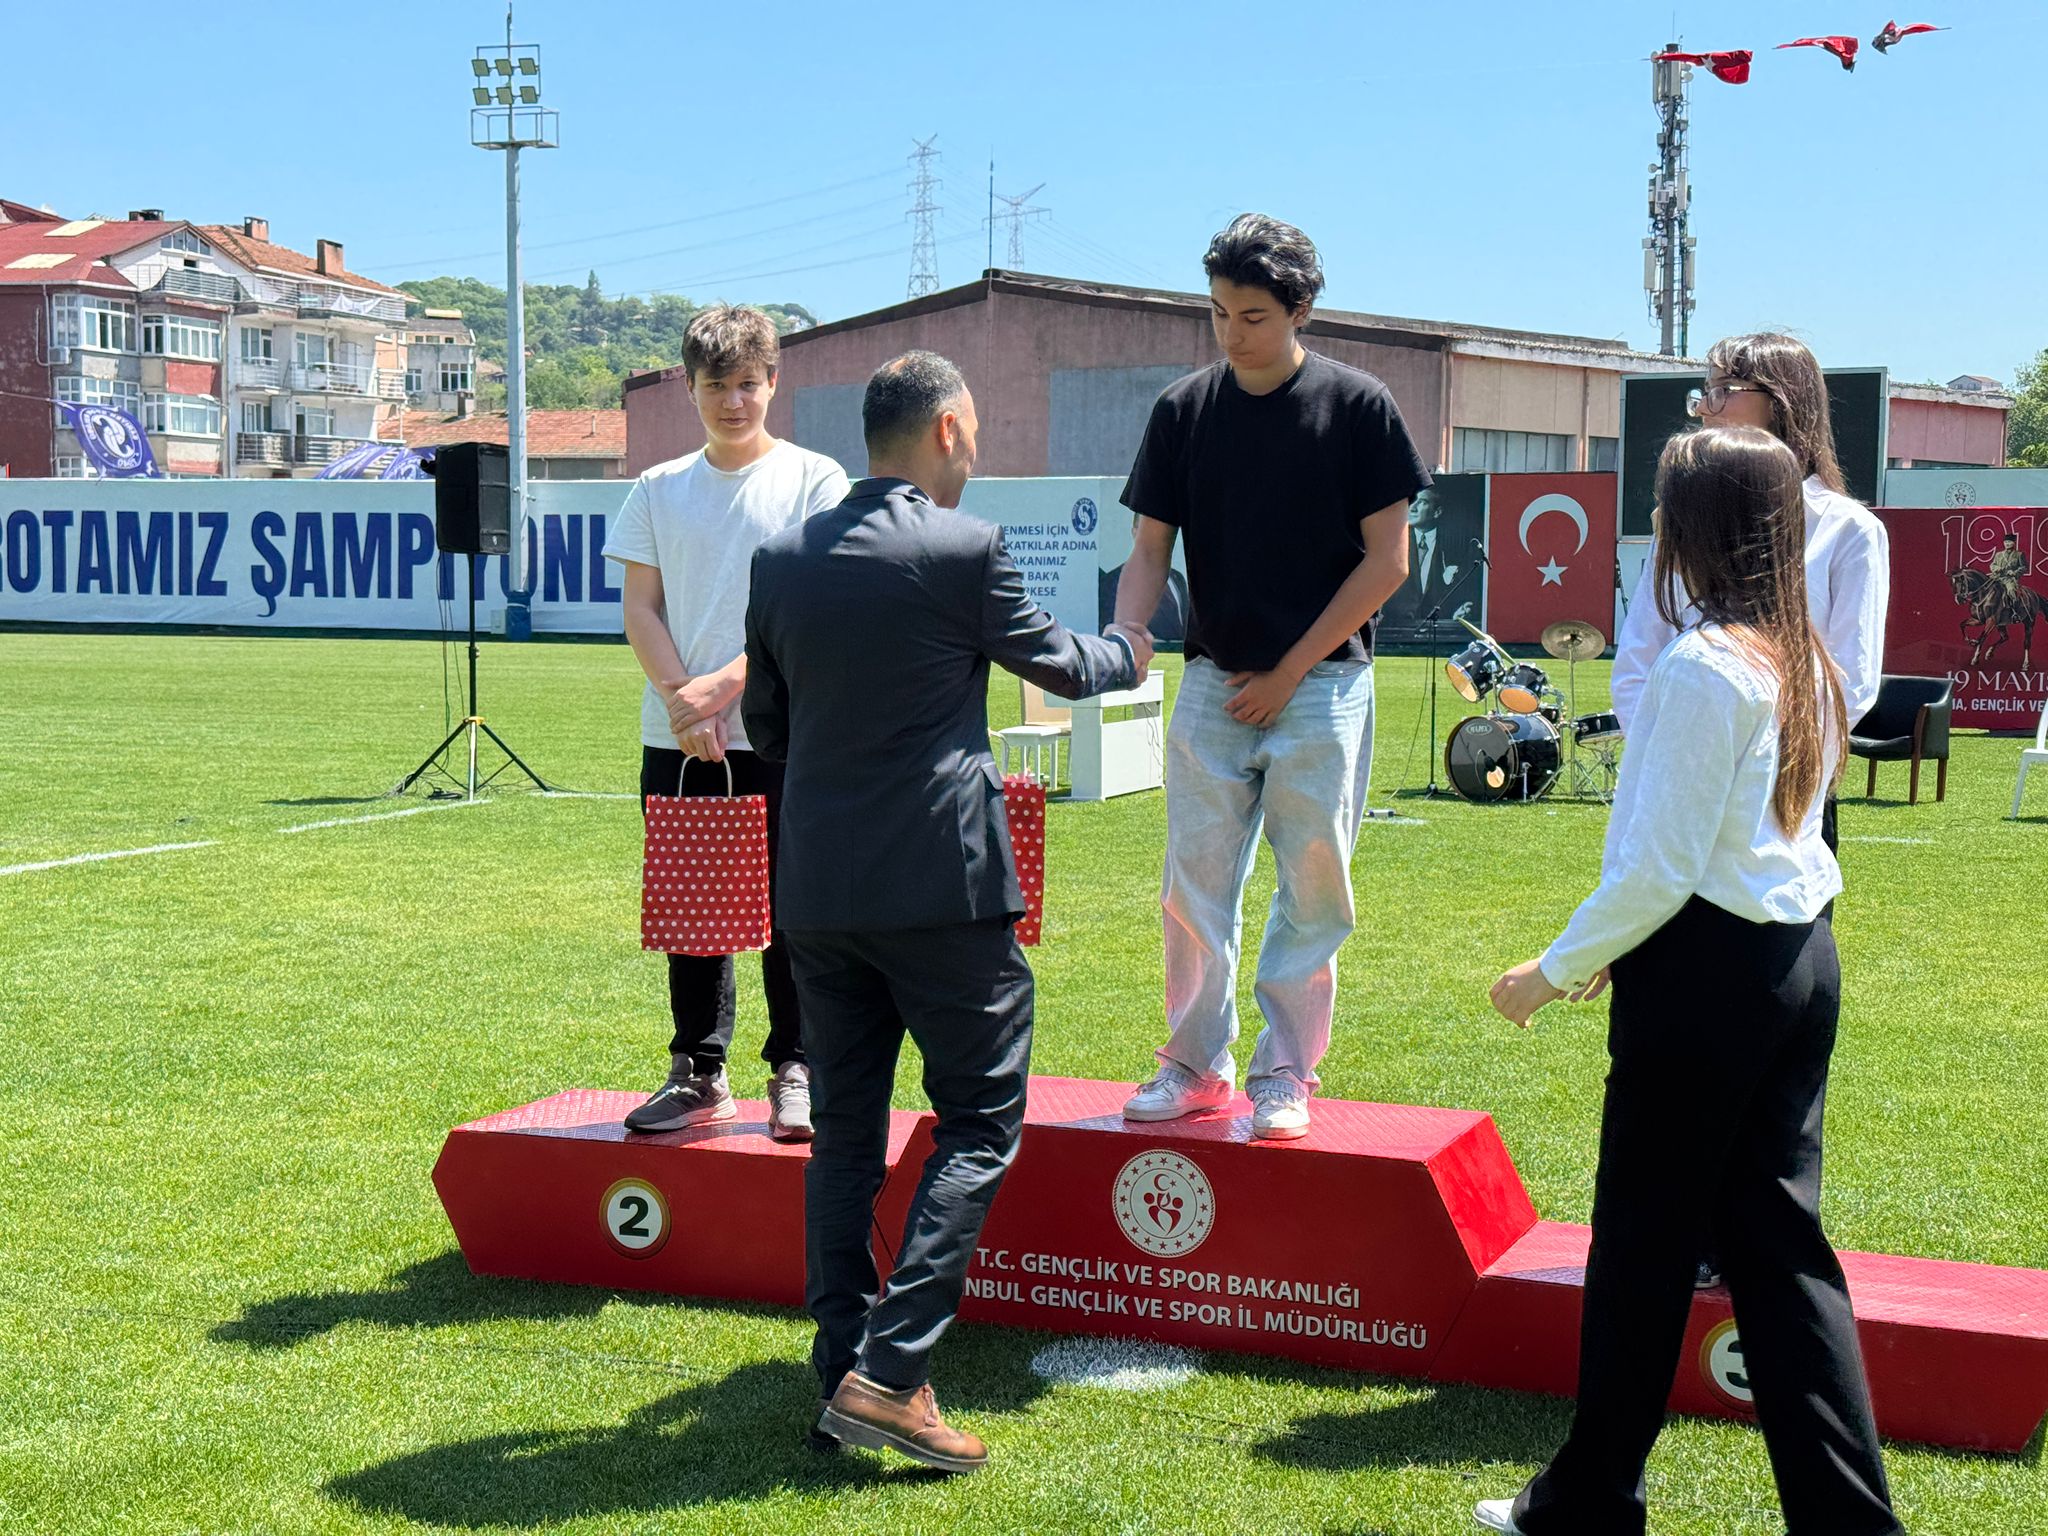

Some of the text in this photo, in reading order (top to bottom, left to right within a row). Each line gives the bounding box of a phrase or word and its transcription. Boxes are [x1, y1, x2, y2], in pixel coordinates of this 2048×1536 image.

[1006, 540, 1097, 551] KATKILAR ADINA
[1046, 523, 1069, 538] İÇİN
[0, 509, 229, 597] OTAMIZ
[1977, 670, 2048, 692] MAYI
[1971, 696, 2025, 714] GENÇLİK
[2029, 700, 2045, 713] VE
[619, 1195, 649, 1238] 2
[976, 1247, 1361, 1310] T.C. GENÇLİK VE SPOR BAKANLIĞI
[964, 1276, 1428, 1350] NBUL GENÇLİK VE SPOR İL MÜDÜRLÜĞÜ
